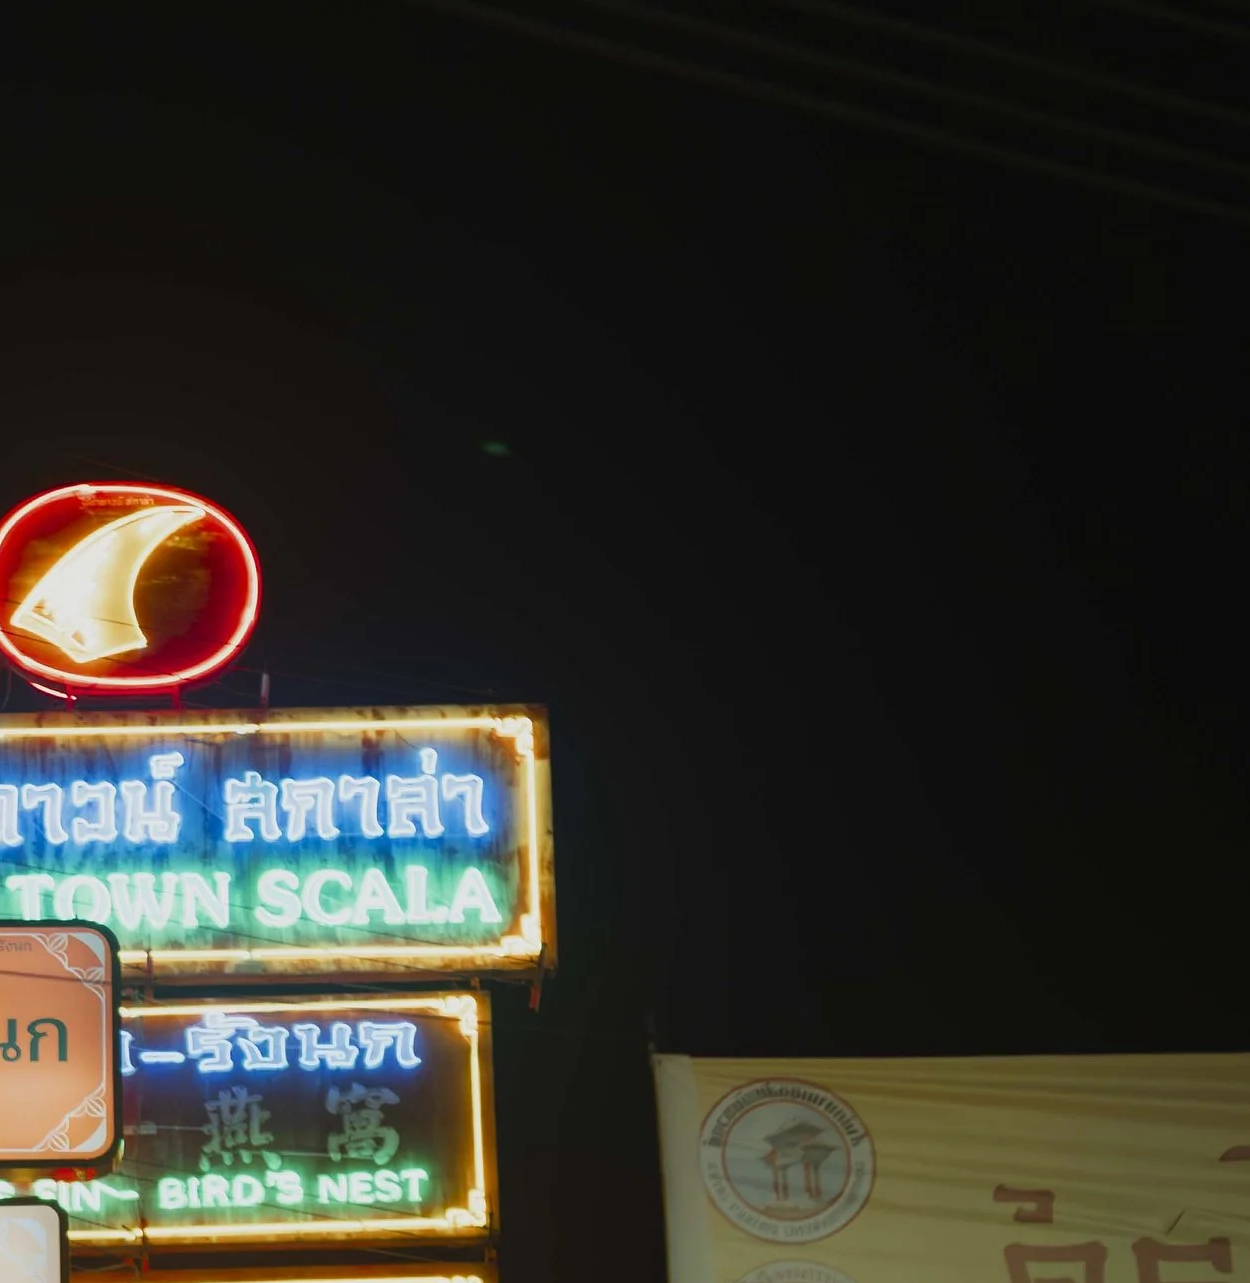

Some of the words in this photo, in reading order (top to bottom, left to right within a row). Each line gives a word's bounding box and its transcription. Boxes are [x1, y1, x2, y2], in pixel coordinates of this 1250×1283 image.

[224, 747, 490, 843] สกาล่า
[7, 872, 230, 930] TOWN
[256, 866, 502, 926] SCALA
[121, 1013, 421, 1074] -รังนก
[158, 1171, 304, 1210] BIRD'S
[317, 1167, 430, 1207] NEST
